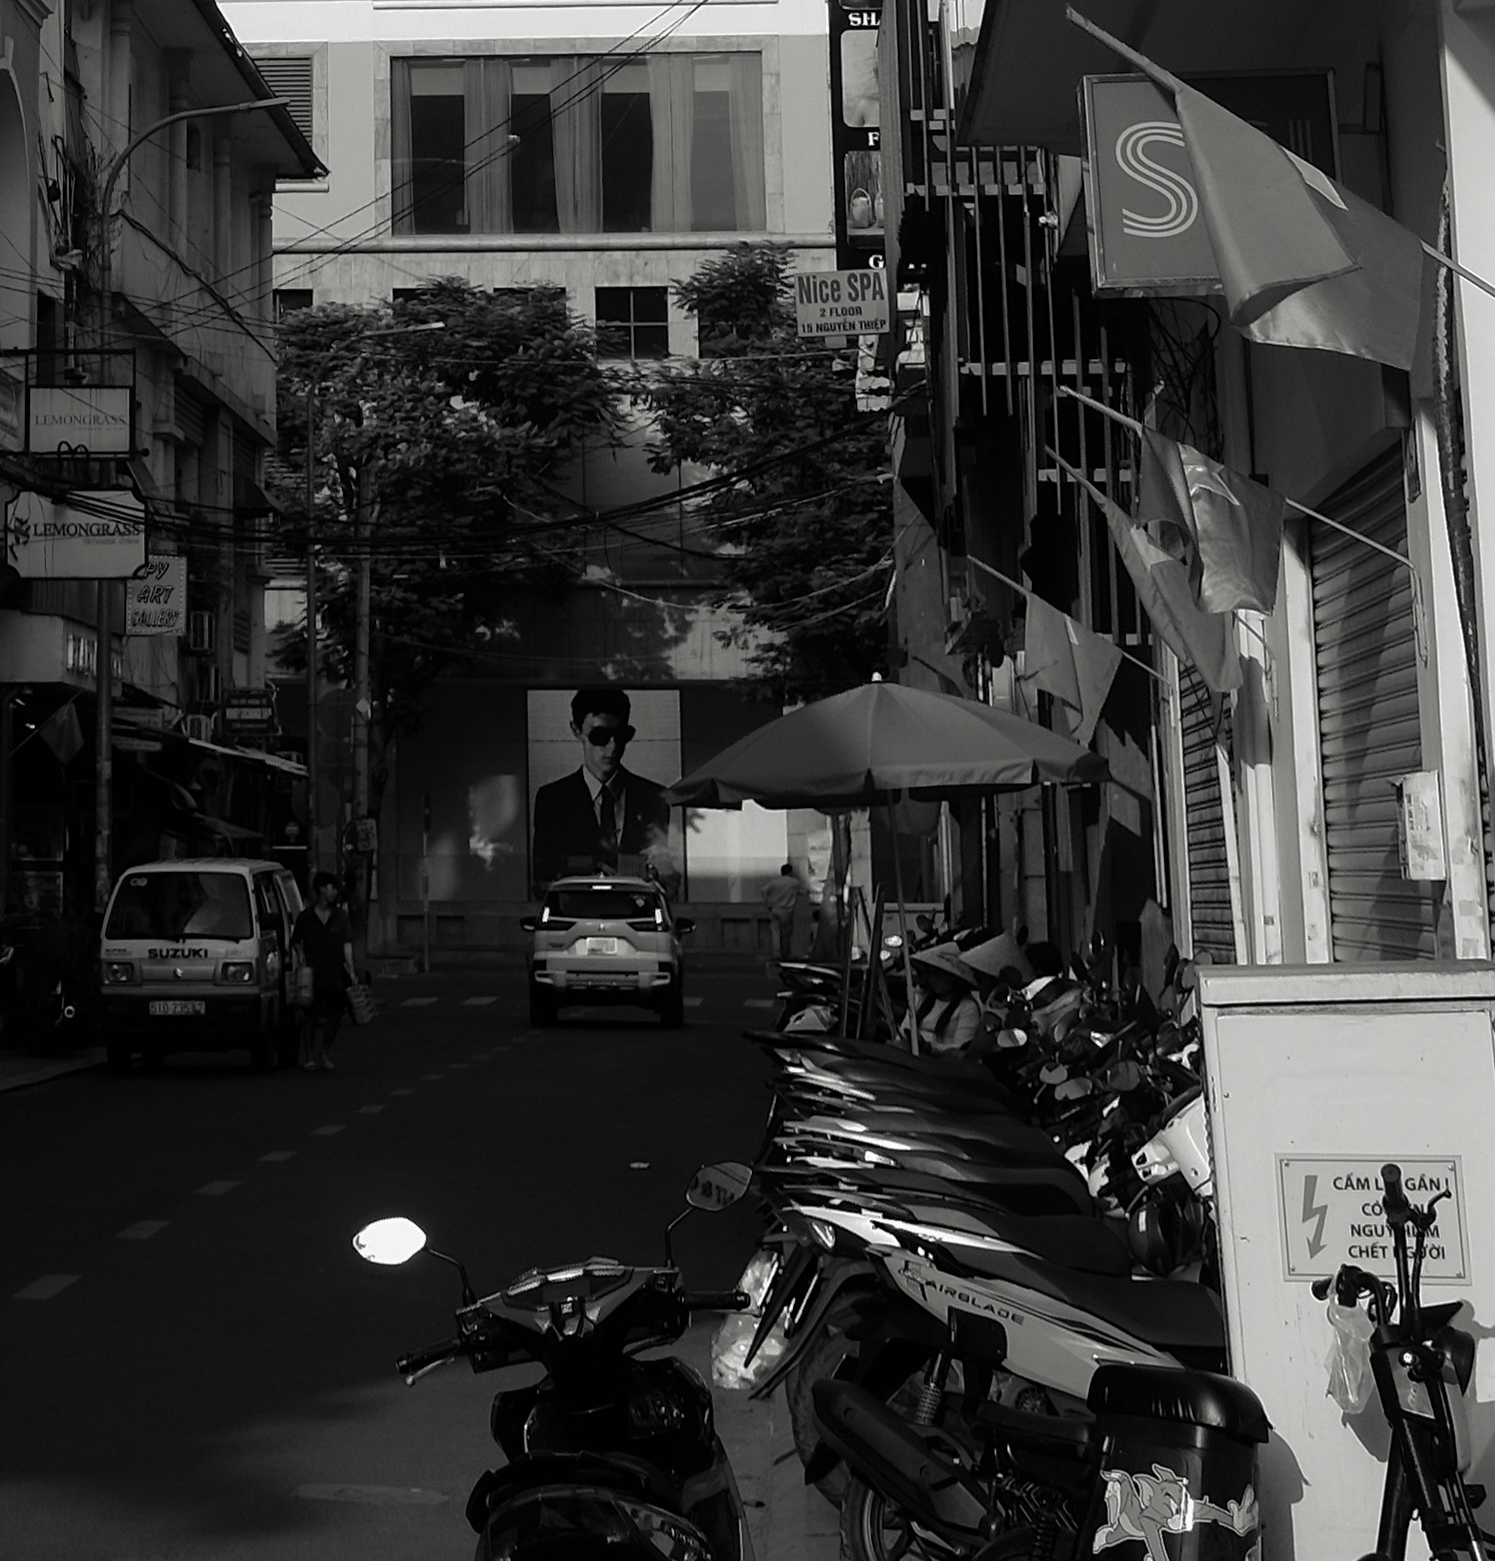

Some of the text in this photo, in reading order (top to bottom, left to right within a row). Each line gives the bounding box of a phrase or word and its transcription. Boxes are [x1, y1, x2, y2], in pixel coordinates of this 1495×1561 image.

[797, 272, 884, 304] Nice SPA
[819, 306, 863, 317] 2 FLOOR
[802, 323, 813, 334] 15
[34, 414, 127, 427] LEMONGRASS
[33, 522, 141, 538] LEMONGRASS
[136, 585, 175, 604] ART
[148, 948, 208, 958] SUZUKI
[1332, 1172, 1370, 1191] CẤM
[1348, 1241, 1388, 1259] CHẾT
